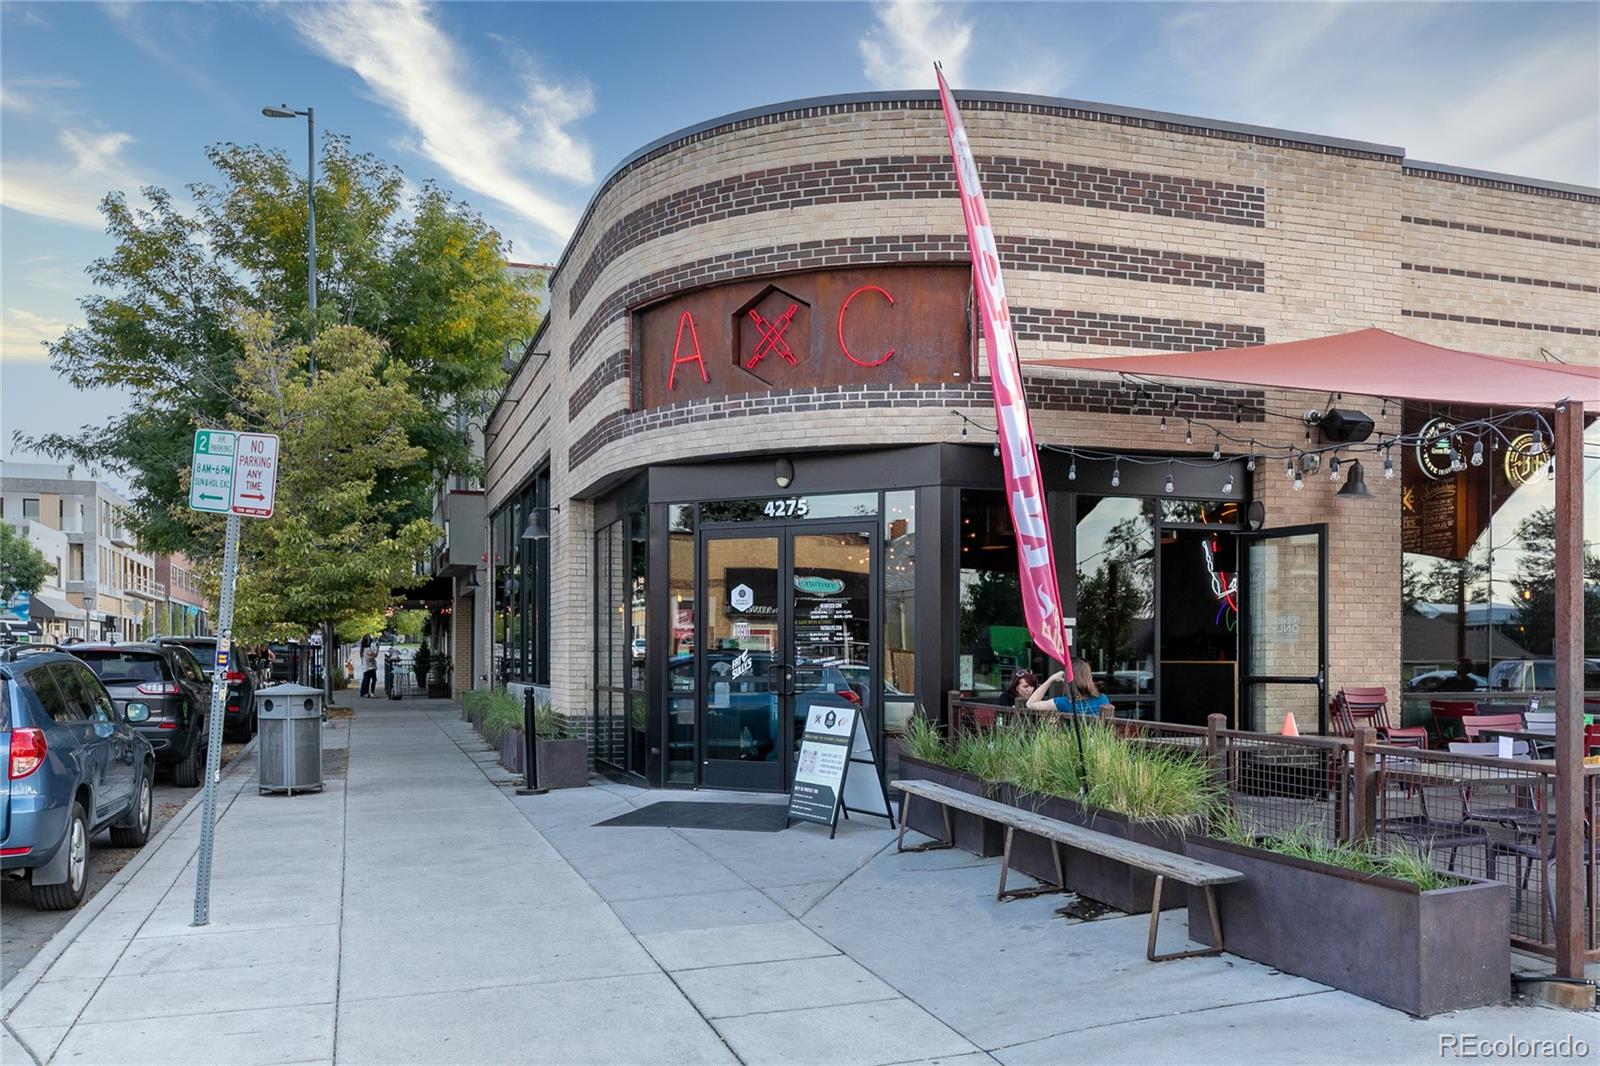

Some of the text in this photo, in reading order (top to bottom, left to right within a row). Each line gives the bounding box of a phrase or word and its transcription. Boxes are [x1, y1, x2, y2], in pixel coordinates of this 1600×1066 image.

[199, 435, 207, 451] 2
[210, 444, 233, 453] PARKING
[250, 440, 264, 454] NO
[239, 455, 272, 469] PARKING
[246, 470, 263, 479] ANY
[246, 481, 262, 491] TIME
[763, 499, 808, 517] 4275
